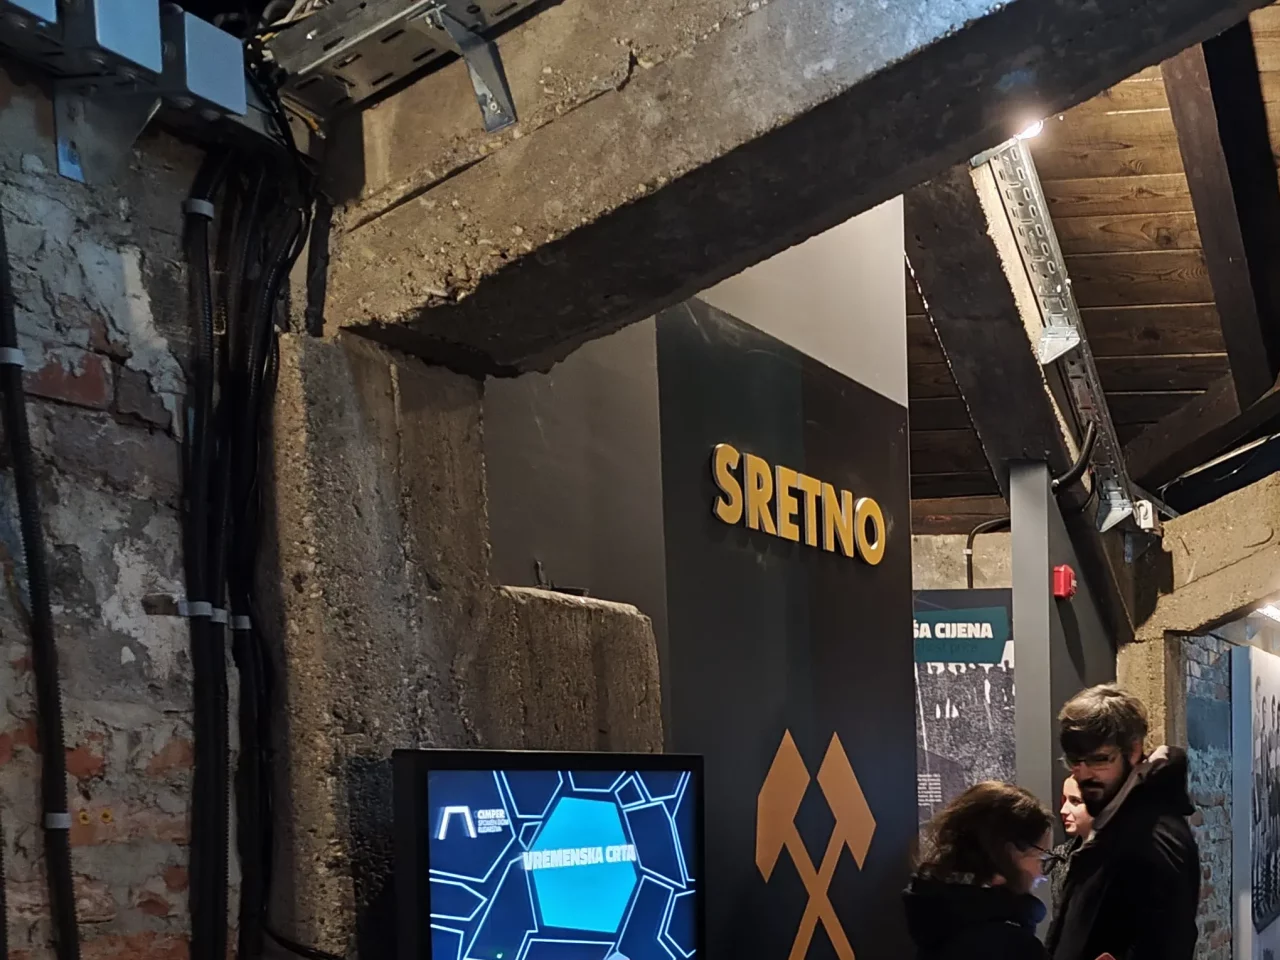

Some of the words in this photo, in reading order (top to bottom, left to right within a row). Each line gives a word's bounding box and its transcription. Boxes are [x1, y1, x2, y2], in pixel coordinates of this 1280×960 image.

[713, 443, 886, 565] SRETNO
[934, 622, 994, 639] CIJENA
[522, 846, 604, 871] VREMENSKA
[605, 844, 637, 863] CRTA
